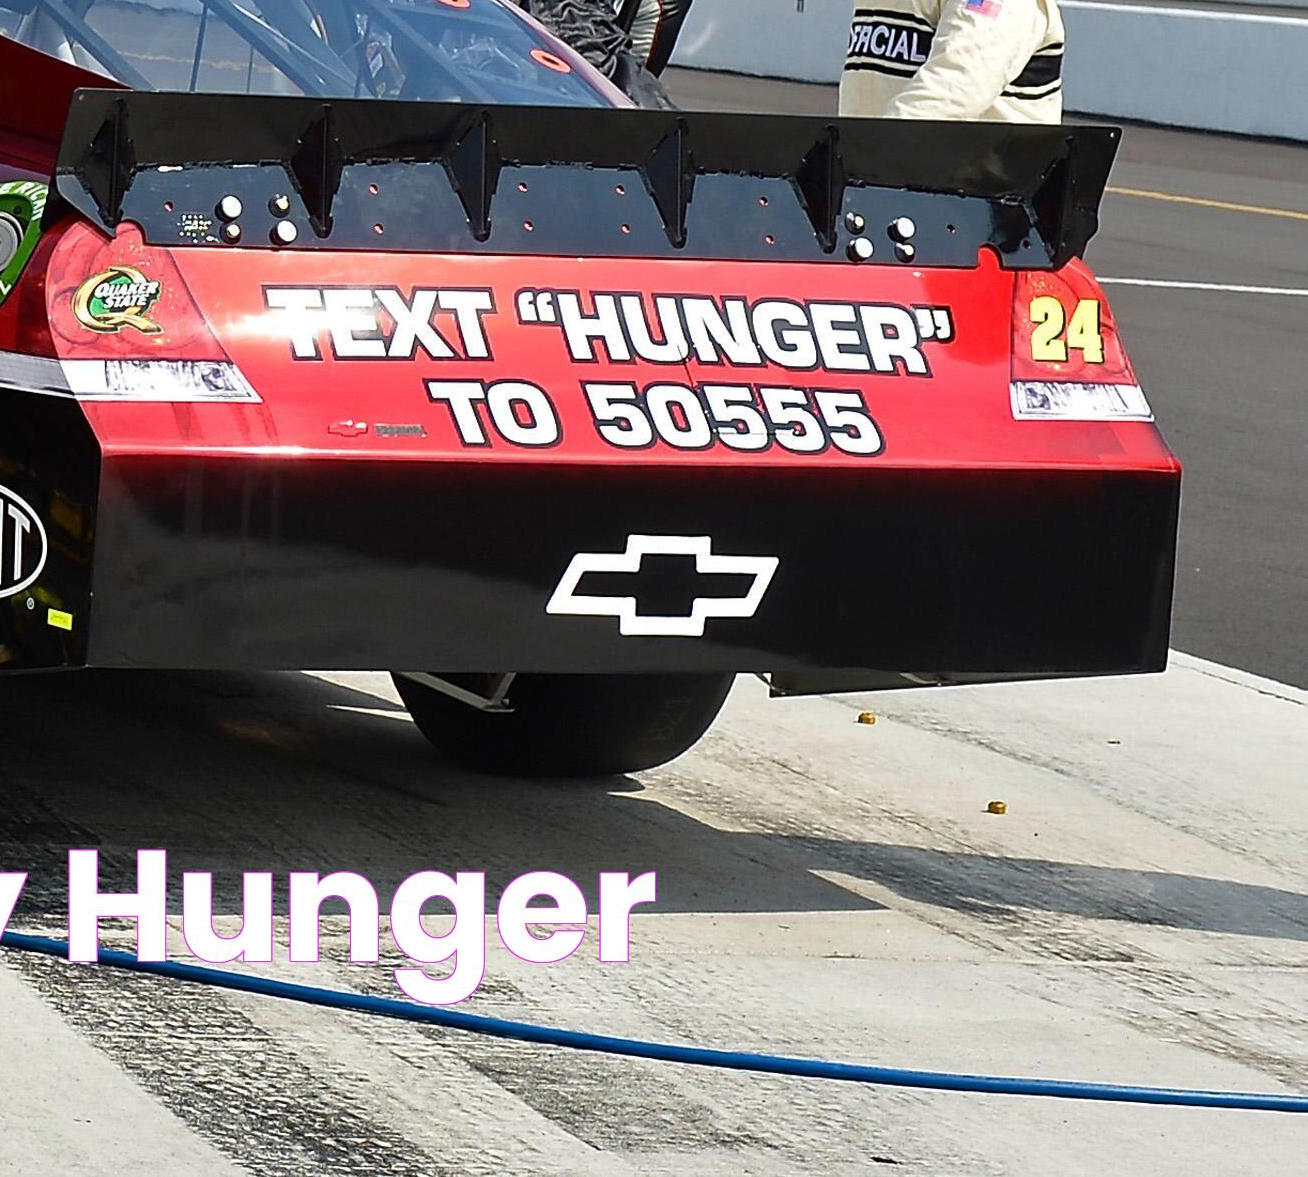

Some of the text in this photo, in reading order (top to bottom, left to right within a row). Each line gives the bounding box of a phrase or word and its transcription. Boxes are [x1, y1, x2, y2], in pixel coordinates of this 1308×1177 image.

[94, 281, 160, 298] QUAKER
[103, 295, 150, 309] STATE
[264, 286, 495, 360] TEXT
[1029, 295, 1105, 364] 24
[423, 378, 885, 455] TO 50555
